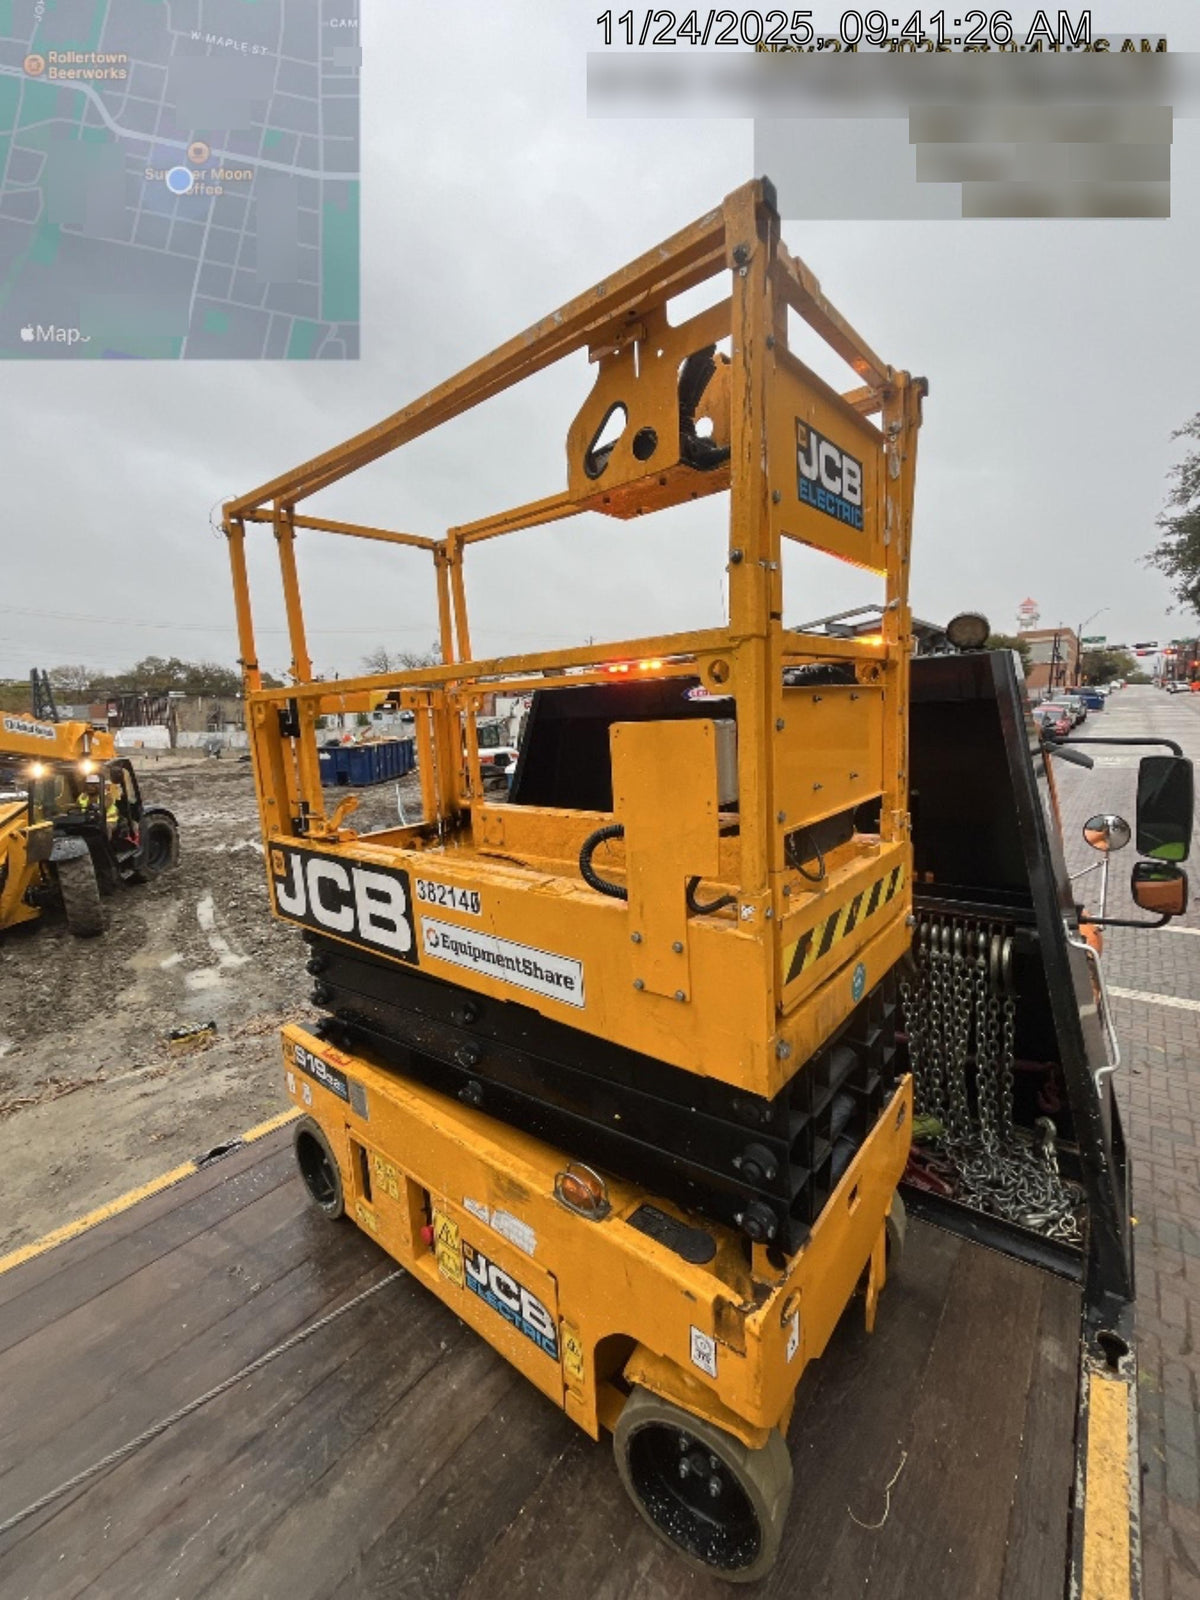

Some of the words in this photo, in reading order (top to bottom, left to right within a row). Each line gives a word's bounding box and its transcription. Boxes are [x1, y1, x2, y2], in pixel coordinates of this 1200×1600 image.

[797, 431, 861, 506] JCB
[799, 477, 863, 527] ELECTRIC
[277, 854, 412, 951] JCB
[440, 932, 575, 991] EquipmentShare
[465, 1254, 556, 1340] JCB
[466, 1274, 558, 1360] ELECTRIC
